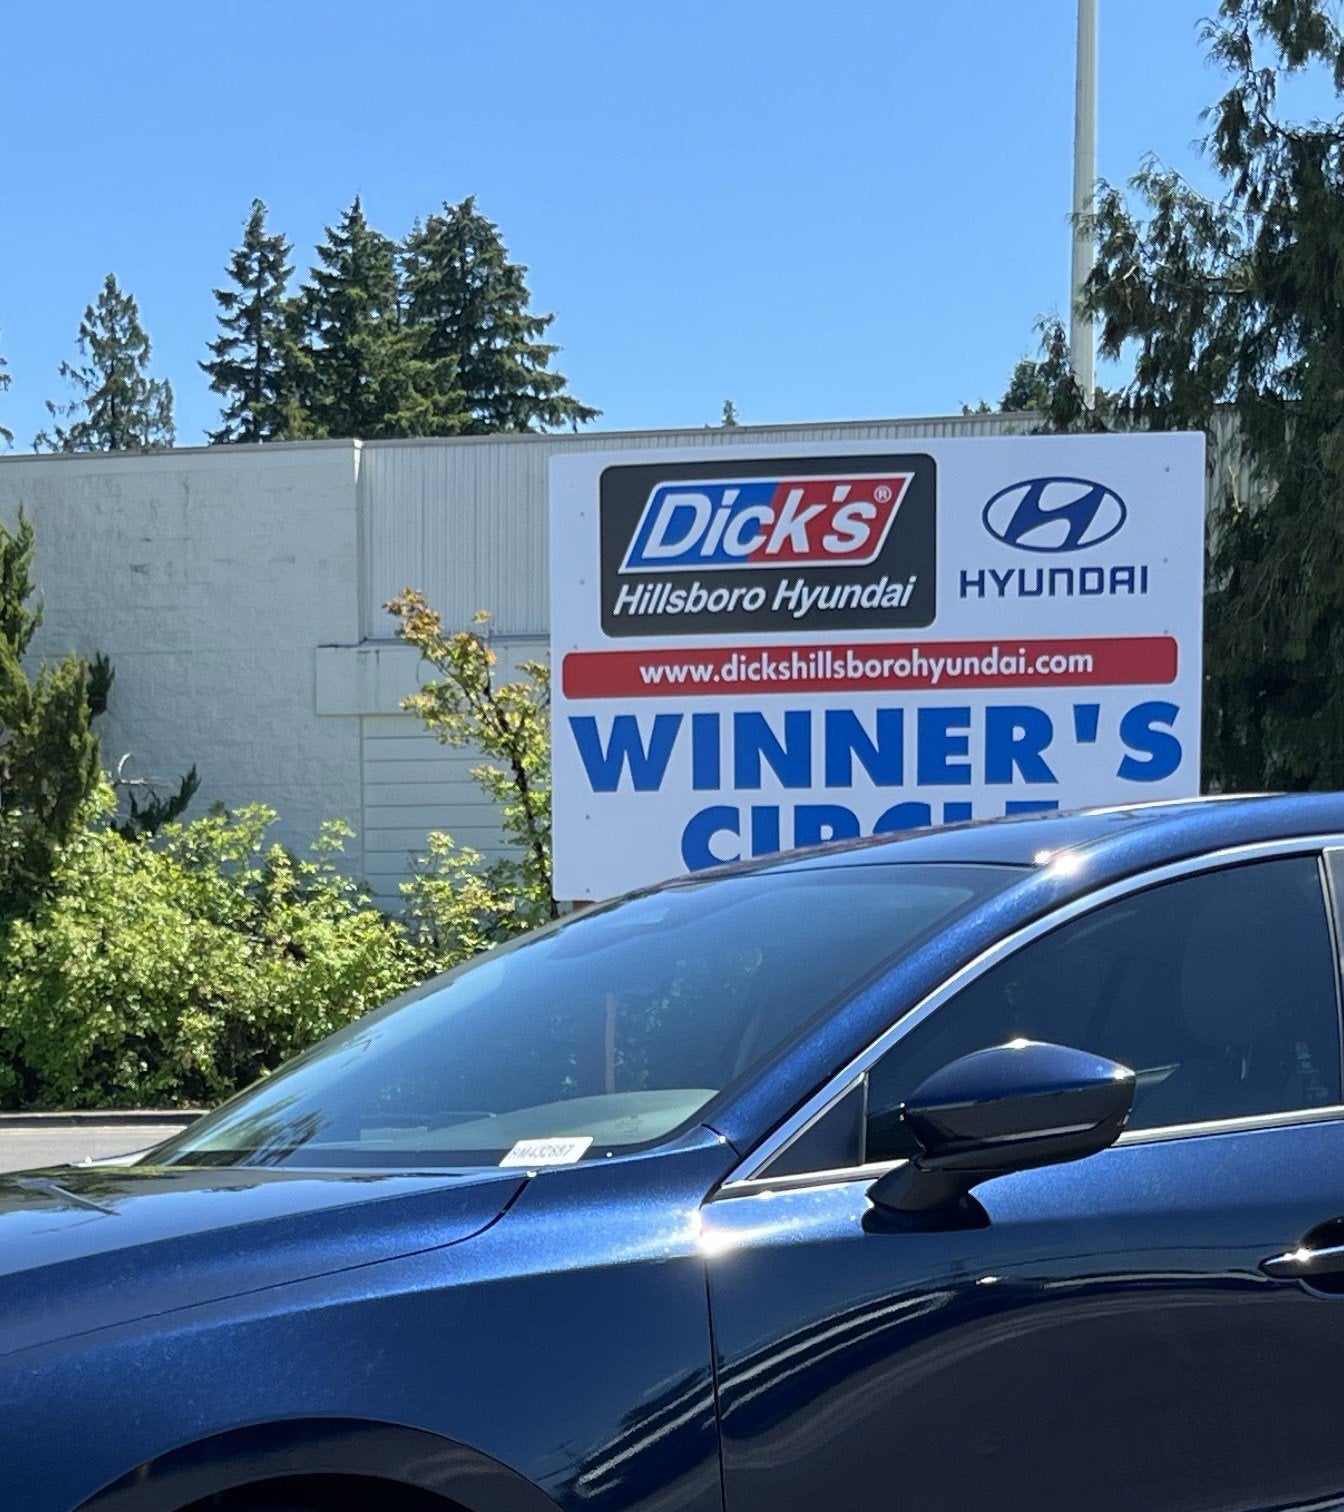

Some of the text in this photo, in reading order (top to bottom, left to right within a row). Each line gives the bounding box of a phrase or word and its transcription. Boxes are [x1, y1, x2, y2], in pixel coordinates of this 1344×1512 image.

[641, 485, 878, 560] Dick's
[612, 576, 918, 619] Hillsboro Hyundai
[959, 565, 1149, 599] HYUNDAI
[638, 647, 1094, 685] www.dickshillsborohyundai.com
[567, 700, 1183, 793] WINNER'S
